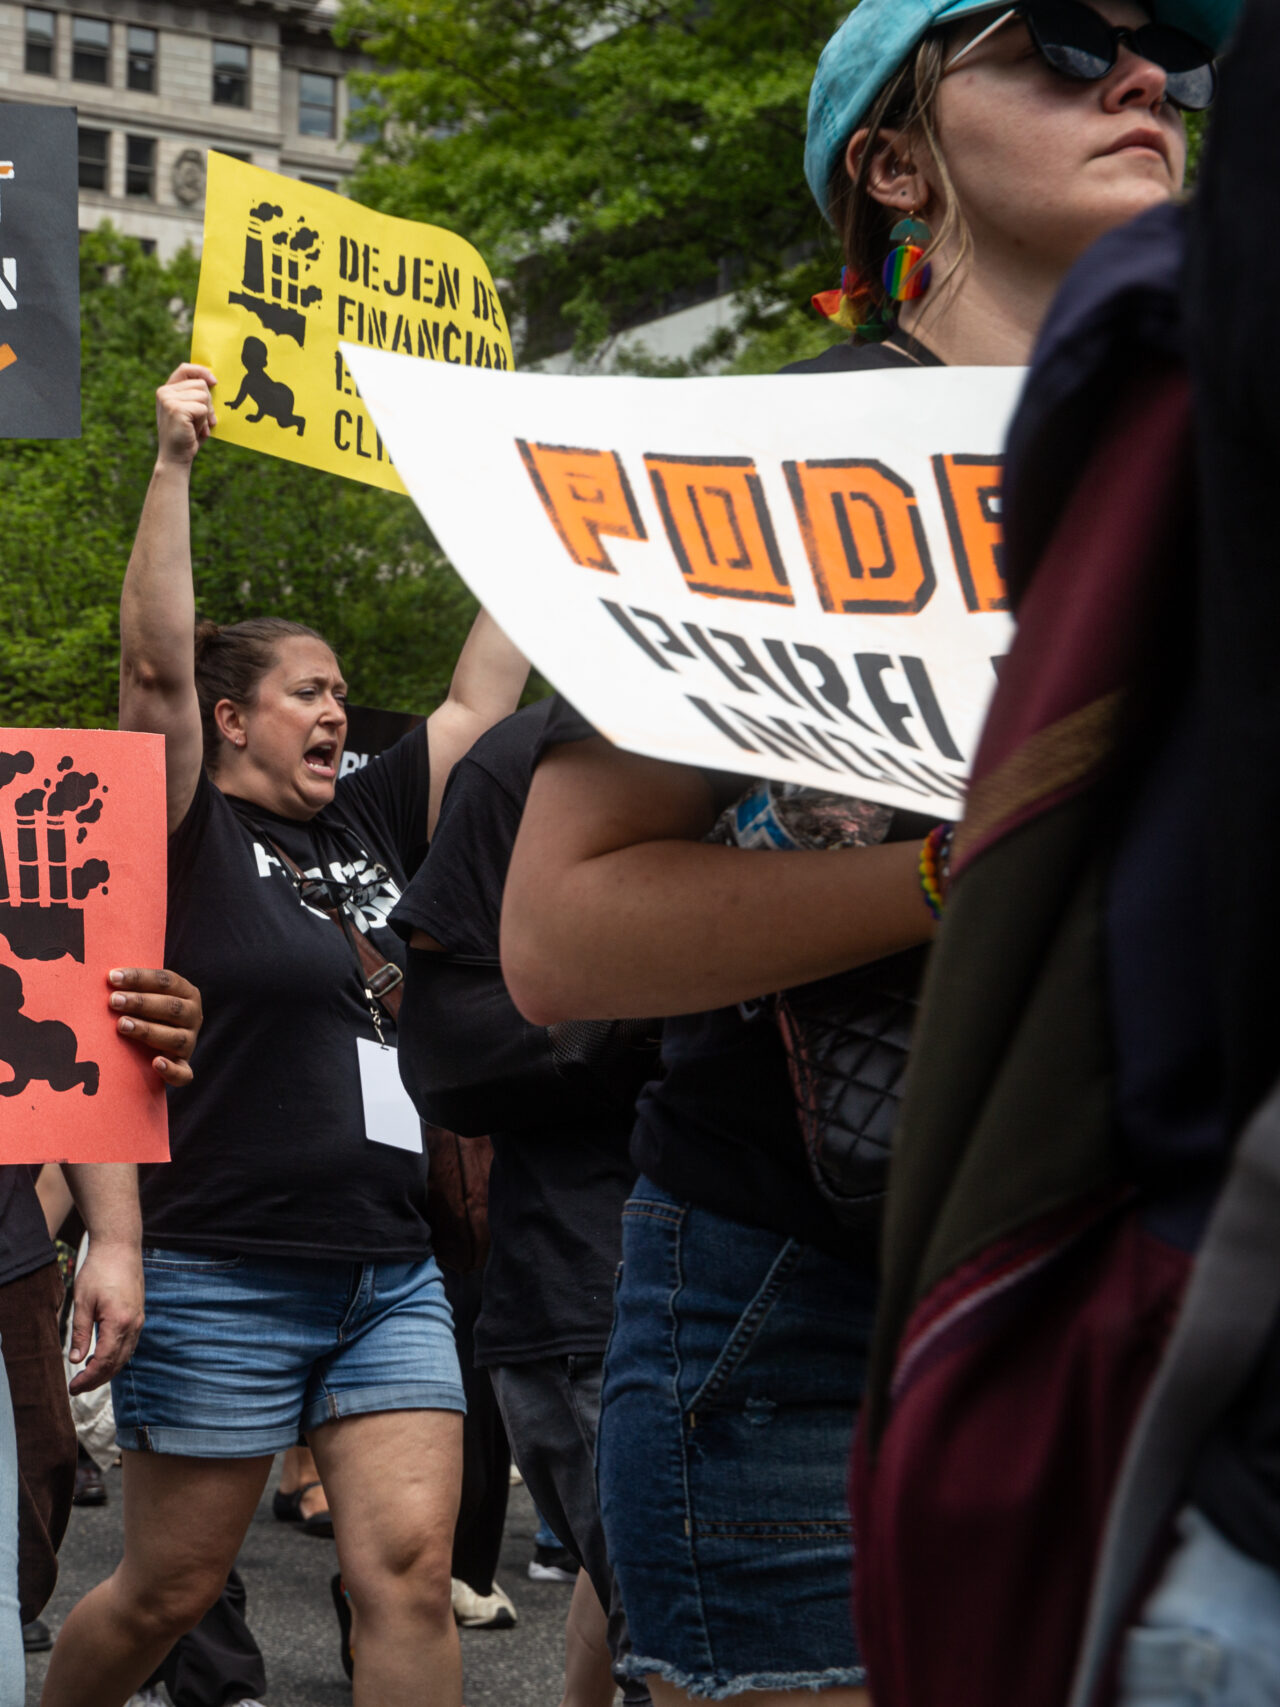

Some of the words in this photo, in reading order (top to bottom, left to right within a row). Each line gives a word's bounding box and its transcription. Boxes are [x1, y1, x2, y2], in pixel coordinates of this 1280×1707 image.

[338, 235, 460, 311] DEJEN
[472, 275, 502, 333] DE
[334, 409, 394, 465] CLI
